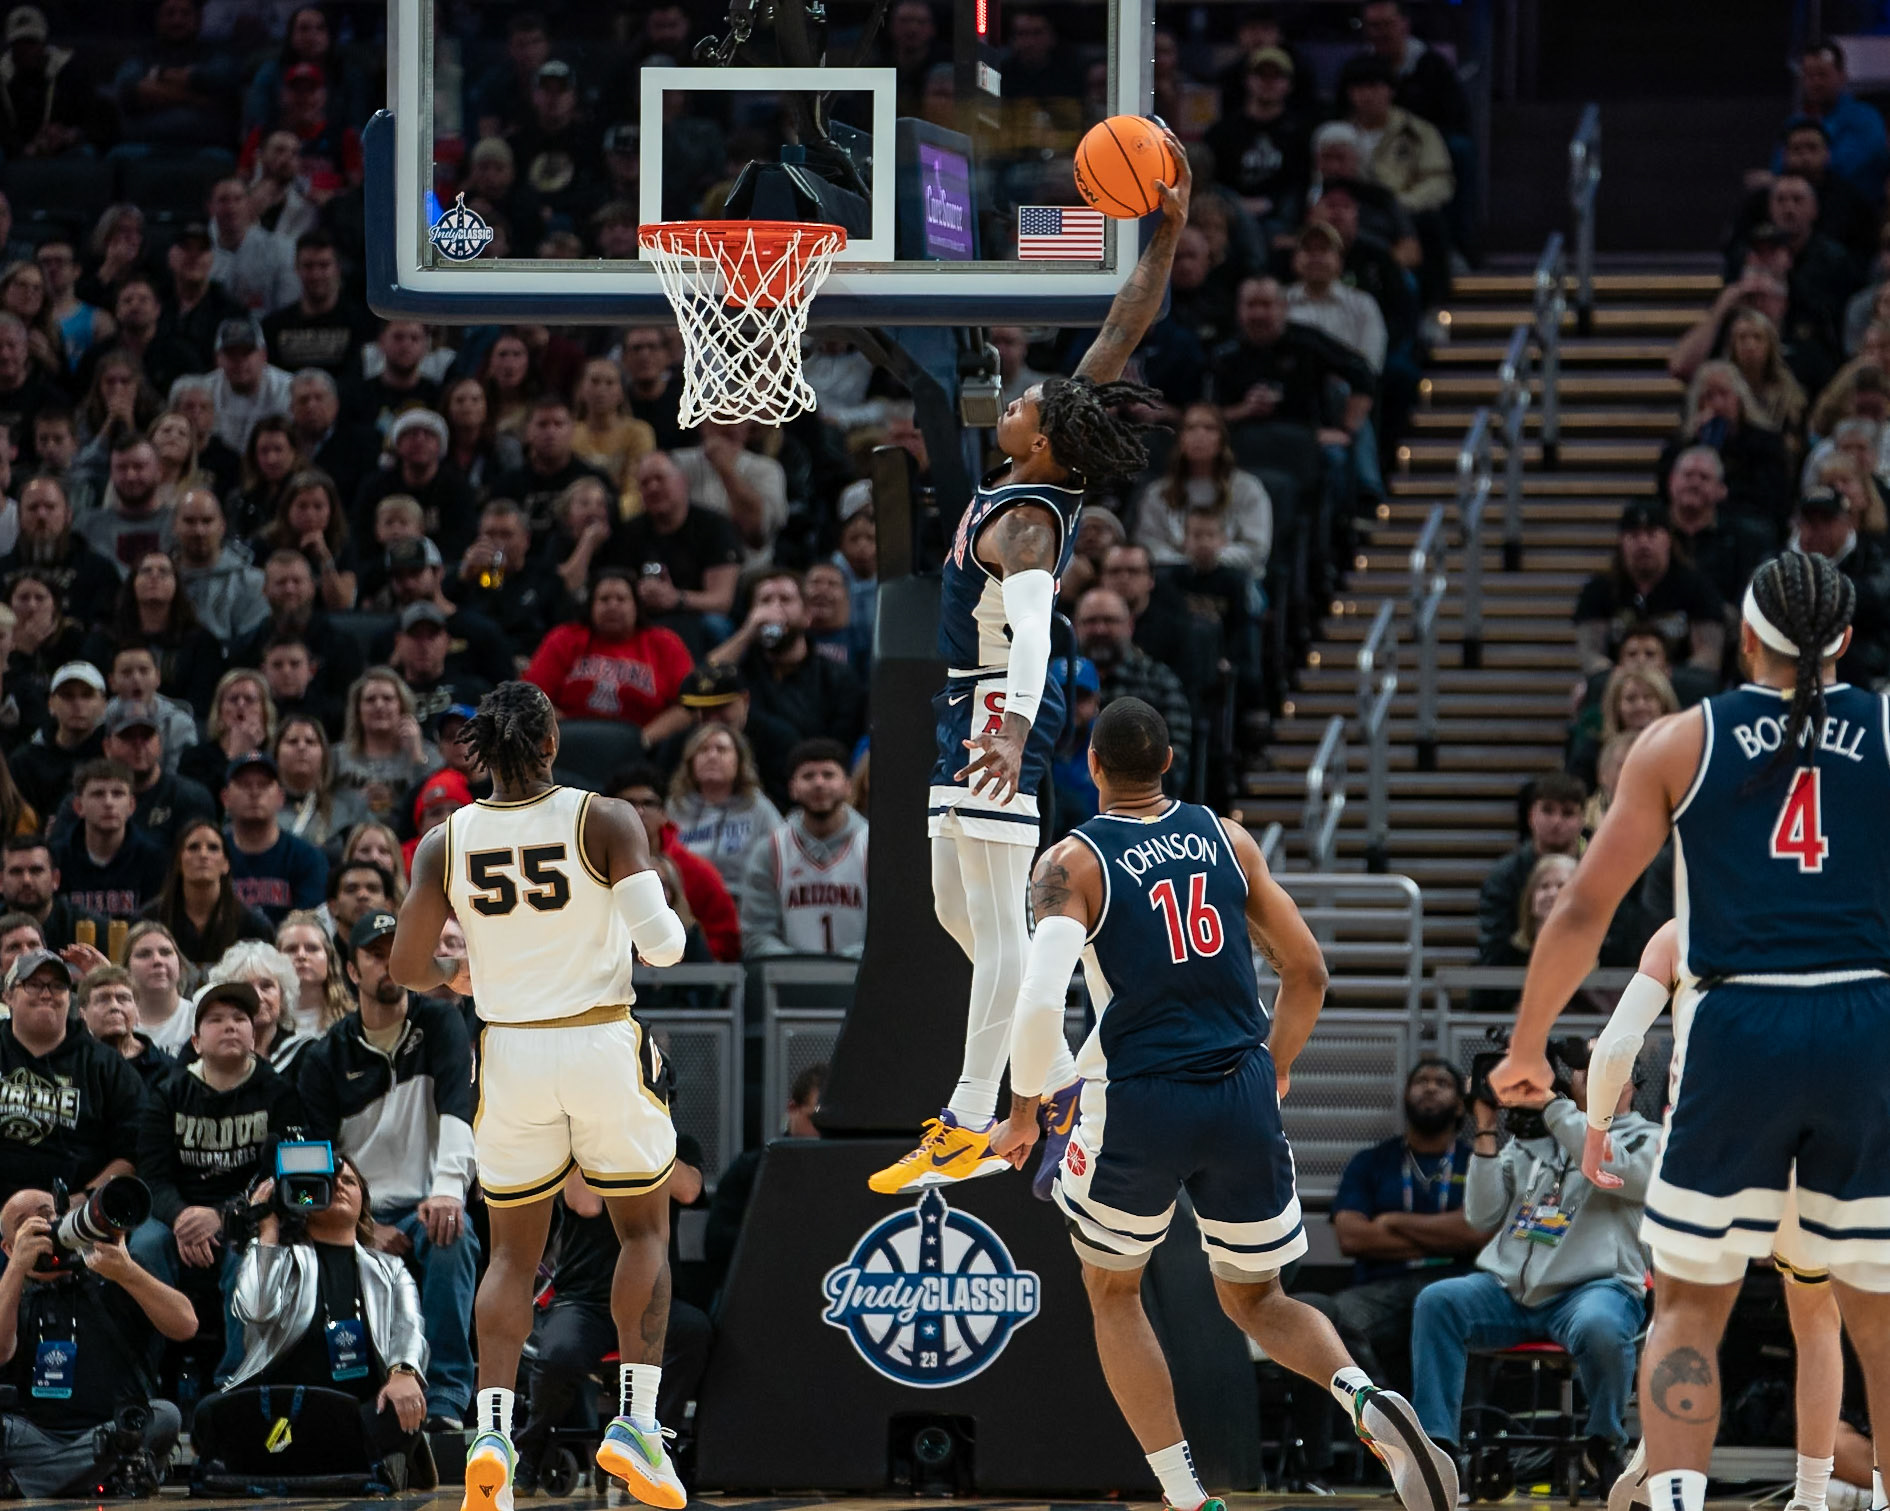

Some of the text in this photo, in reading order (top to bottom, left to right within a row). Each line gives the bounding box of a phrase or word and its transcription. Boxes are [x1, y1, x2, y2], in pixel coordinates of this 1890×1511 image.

[1769, 766, 1830, 874] 4
[465, 842, 572, 917] 55
[1115, 832, 1217, 888] JOHNSON
[787, 883, 862, 909] ARIZONA
[1148, 871, 1225, 964] 16
[821, 913, 834, 953] 1
[919, 1352, 939, 1368] 23
